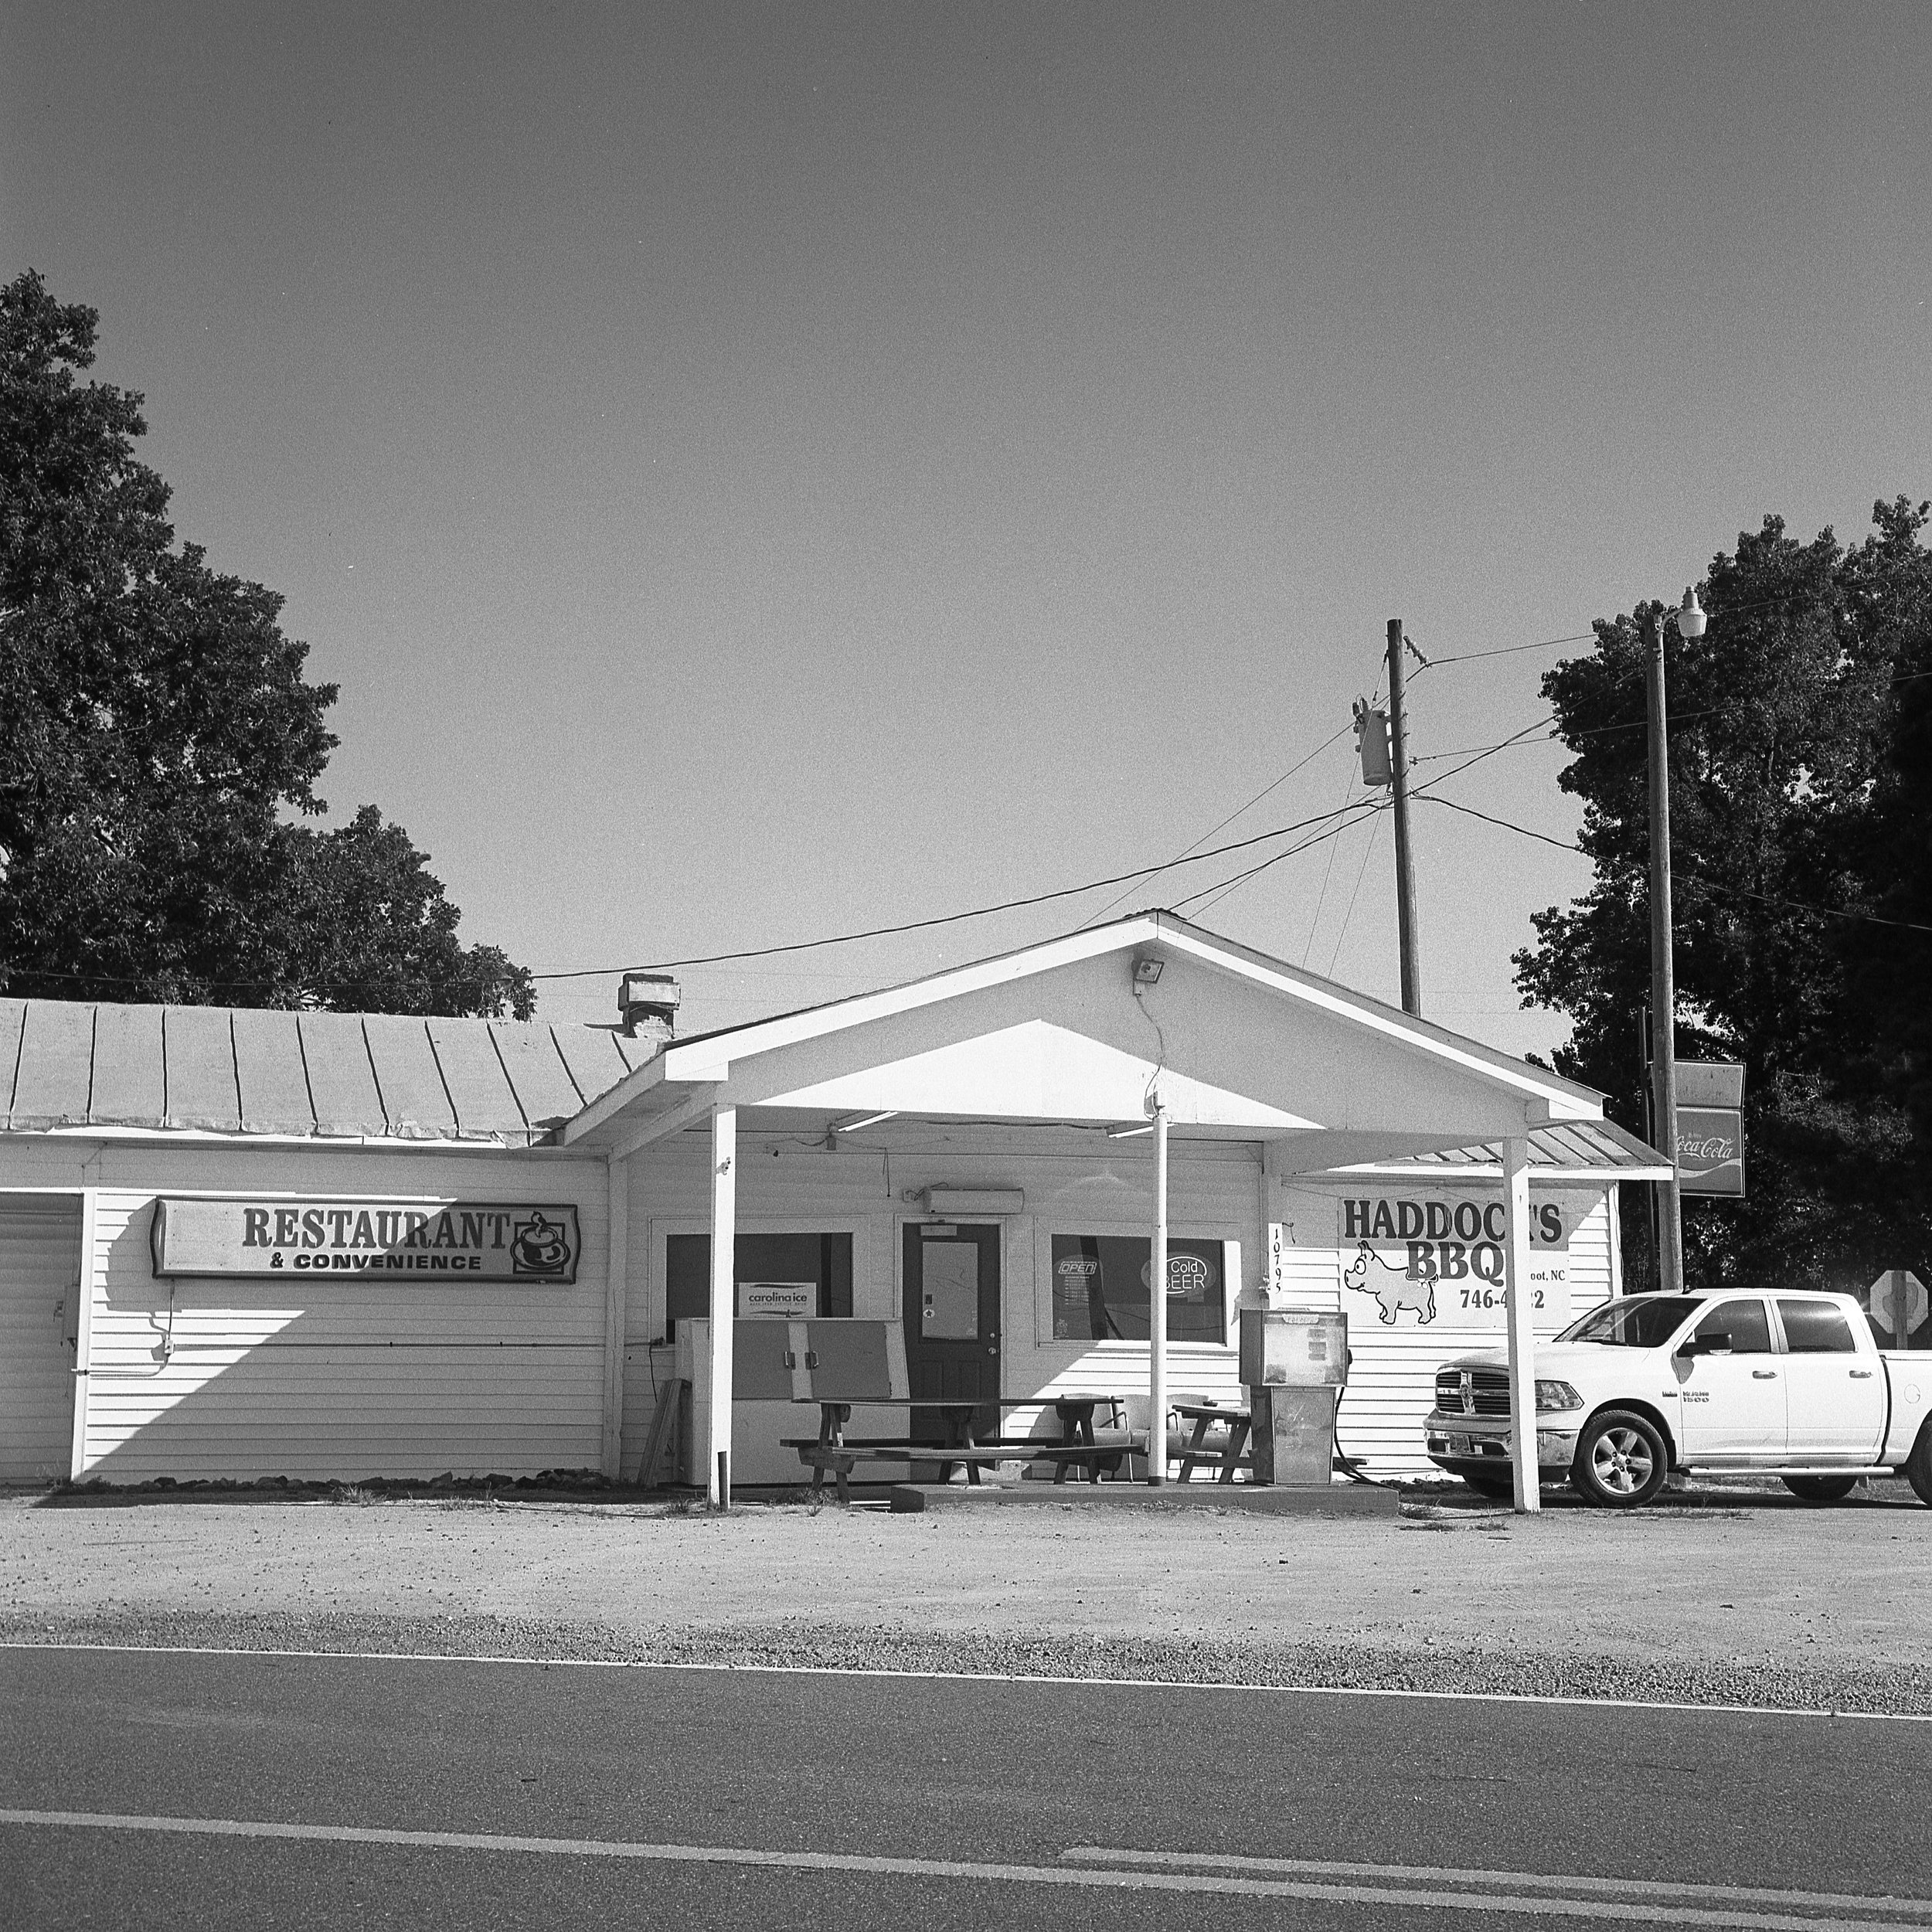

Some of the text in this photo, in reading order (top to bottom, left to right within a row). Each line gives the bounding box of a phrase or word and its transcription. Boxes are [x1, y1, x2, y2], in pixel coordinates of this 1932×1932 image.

[242, 1207, 512, 1250] RESTAURANT
[1343, 1200, 1563, 1243] HADDOC'S
[270, 1251, 482, 1270] & CONVENIENCE
[1061, 1264, 1094, 1272] OPEN
[1171, 1260, 1198, 1273] Cold
[1406, 1240, 1505, 1287] BBQ
[1550, 1270, 1566, 1281] NC
[748, 1291, 807, 1302] carolina ice
[1460, 1289, 1544, 1308] 746-42
